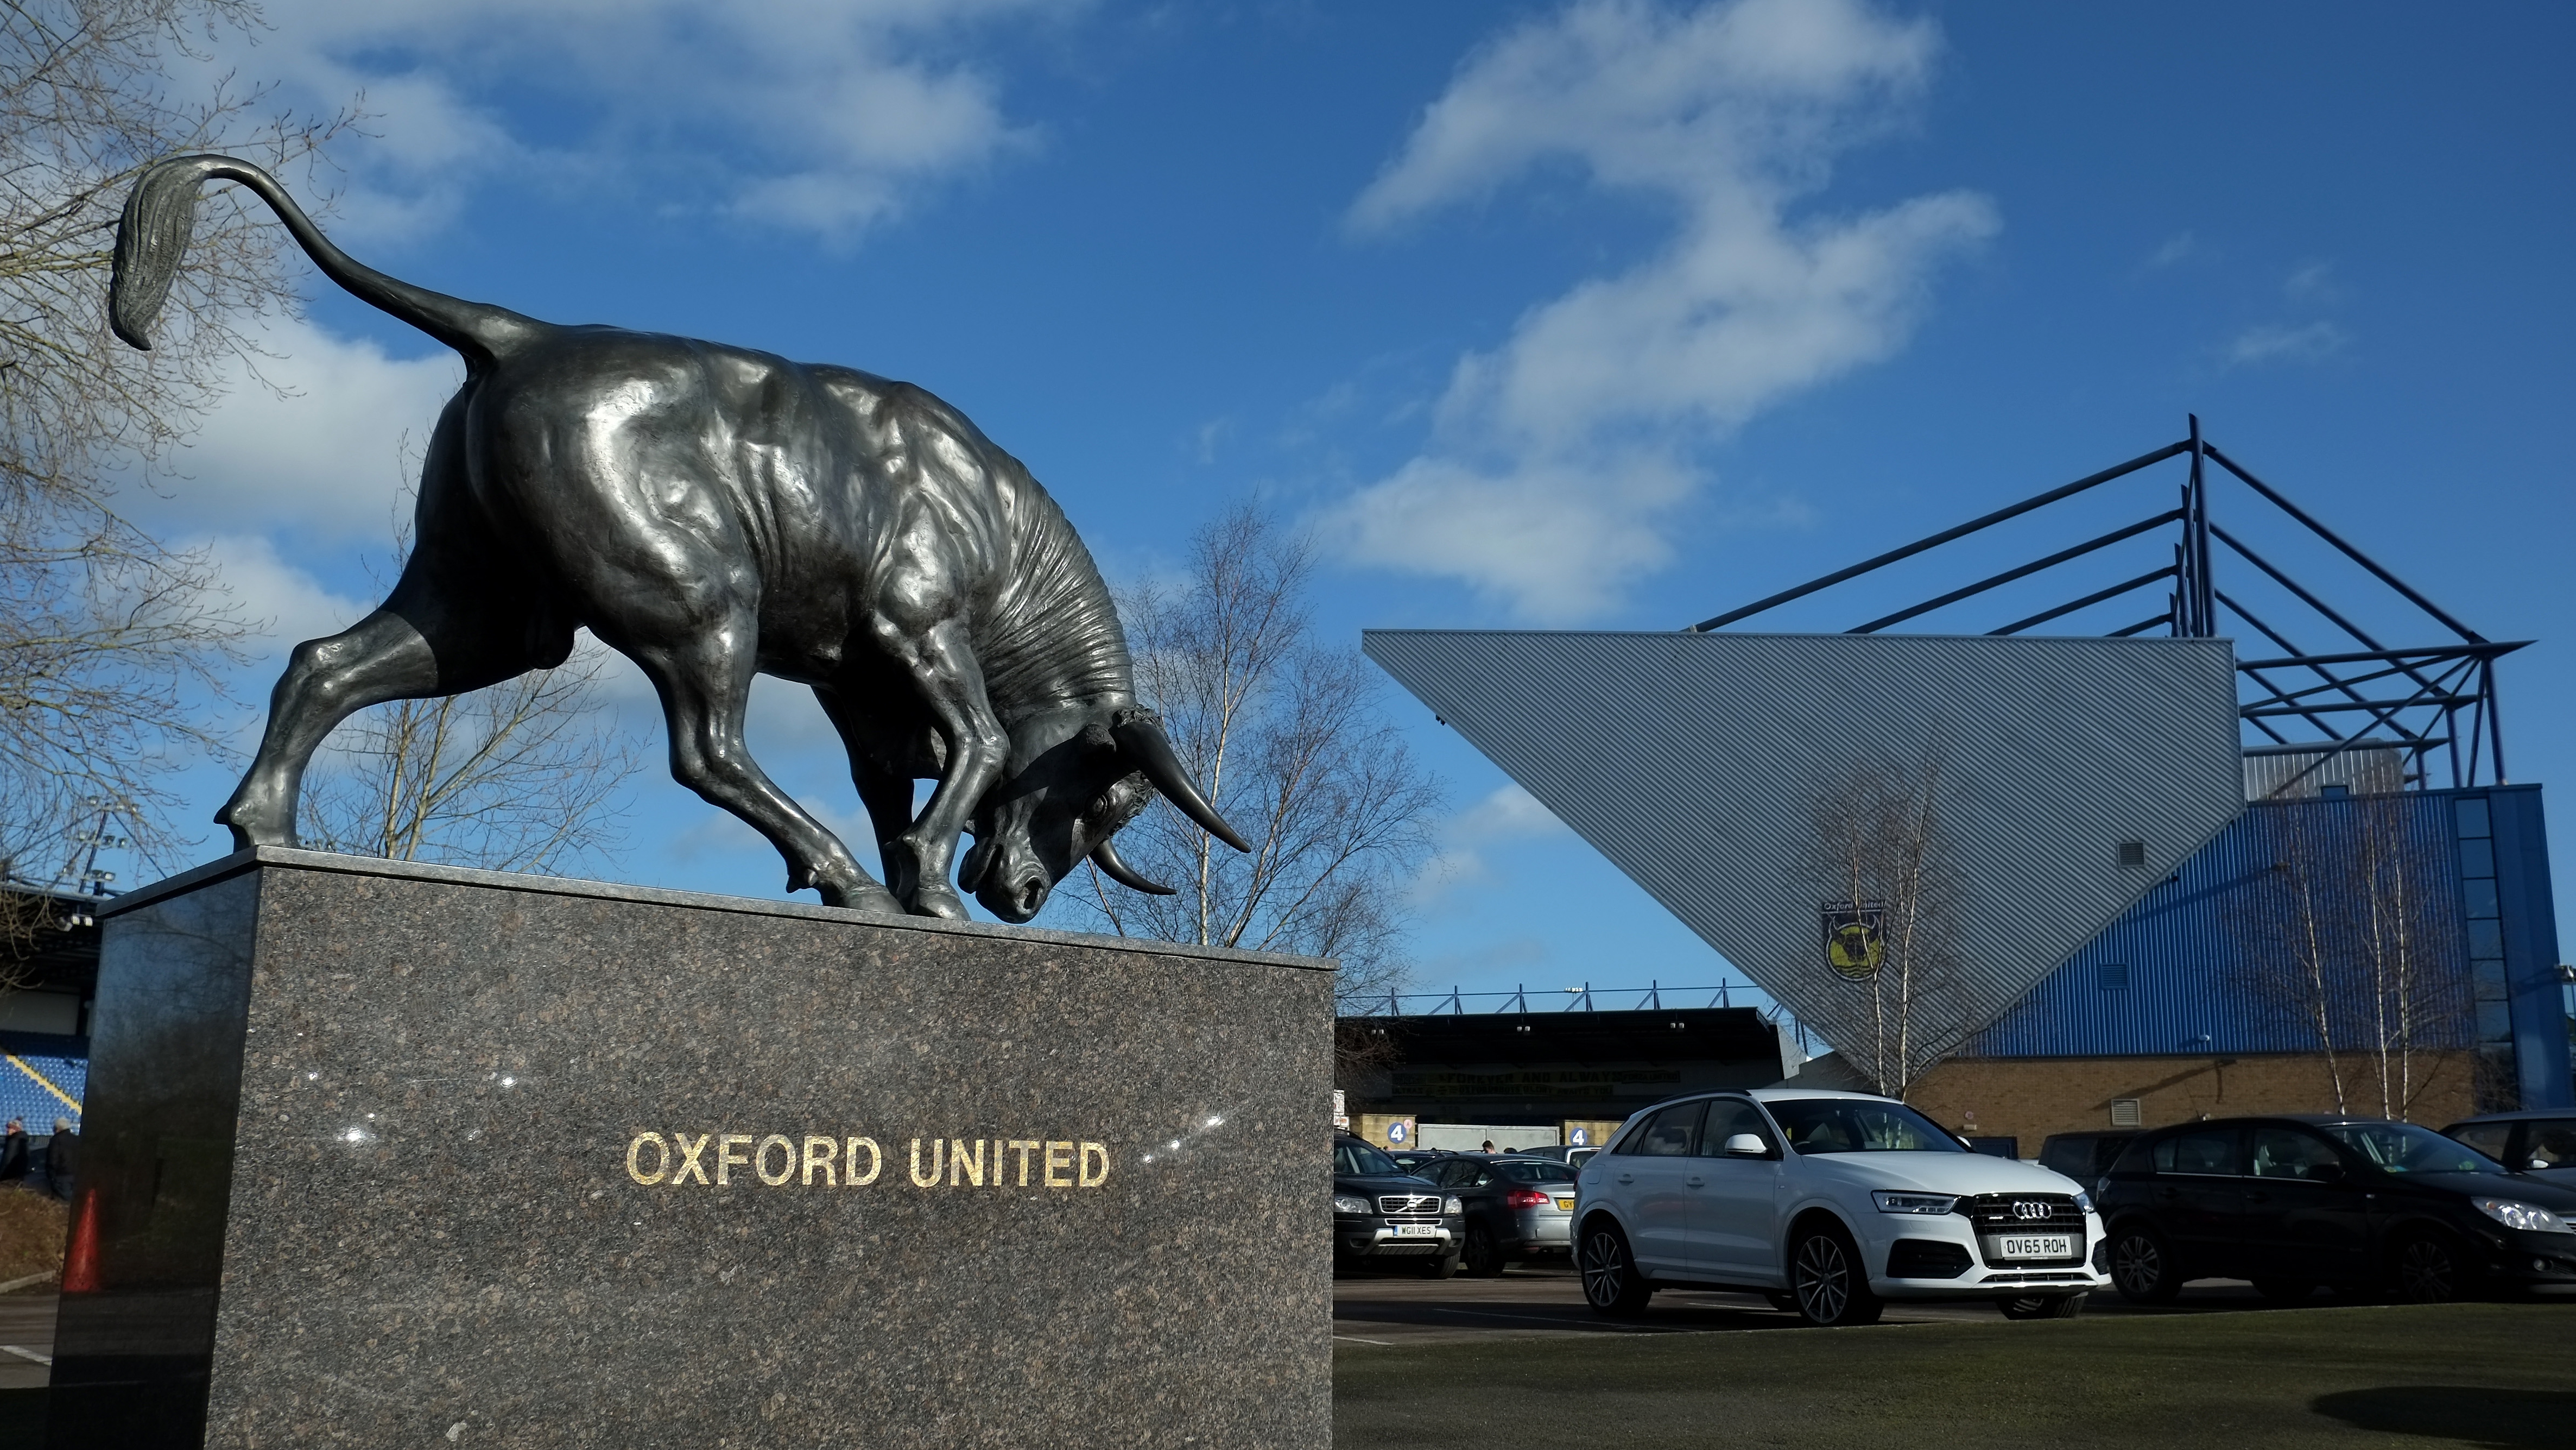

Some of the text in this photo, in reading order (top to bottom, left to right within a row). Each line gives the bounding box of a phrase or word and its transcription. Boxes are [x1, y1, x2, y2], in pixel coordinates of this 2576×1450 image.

[1824, 901, 1853, 911] Oxford
[1447, 1071, 1622, 1083] FOREVER AND ALWAYS
[1390, 1125, 1403, 1141] 4
[1572, 1130, 1585, 1145] 4
[625, 1131, 1111, 1188] OXFORD UNITED
[1417, 1226, 1431, 1235] XES
[2007, 1239, 2067, 1254] OV65 ROH
